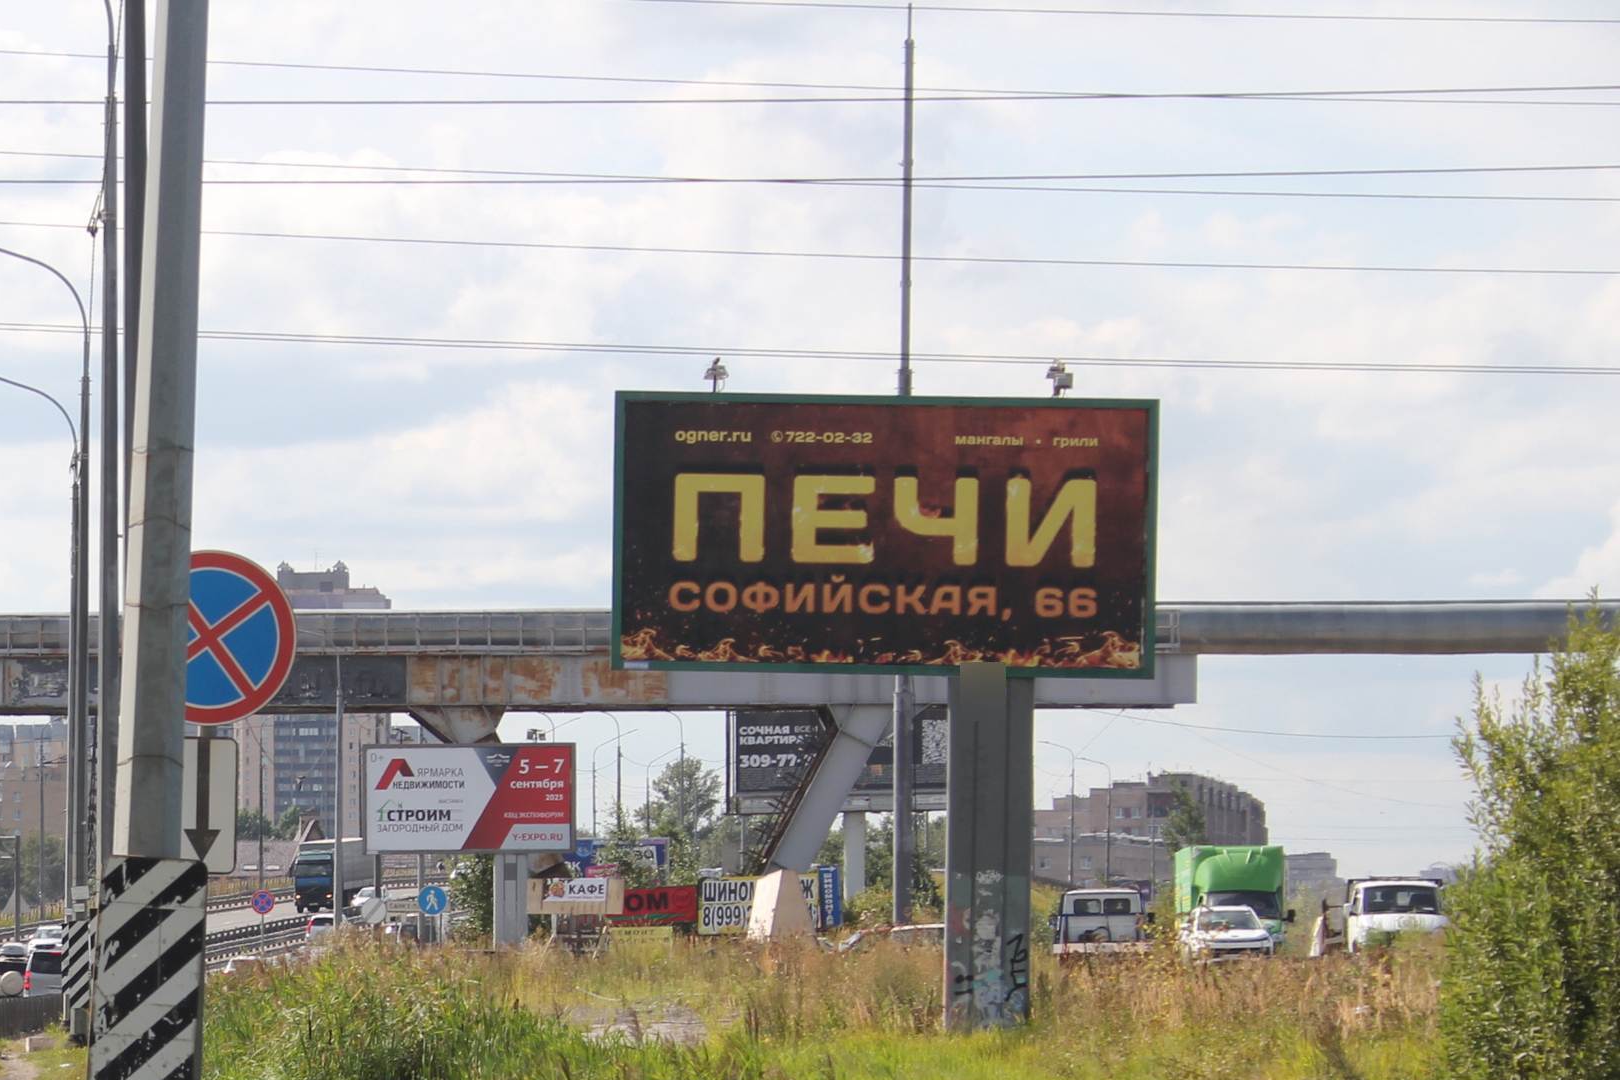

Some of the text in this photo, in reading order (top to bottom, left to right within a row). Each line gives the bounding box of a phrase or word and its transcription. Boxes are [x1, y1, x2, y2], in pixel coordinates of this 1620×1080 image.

[675, 430, 874, 444] ogner.ru 722-02-32
[955, 435, 1098, 449] мангалы грили
[671, 473, 1098, 568] ПЕЧИ
[667, 575, 1099, 622] СОФИЙСКАЯ, 66
[739, 725, 791, 736] СОЧНАЯ
[518, 759, 530, 774] 5
[553, 758, 565, 774] 7
[416, 767, 464, 777] ЯРМАРКА
[392, 780, 465, 790] НЕДВИЖИМОСТИ
[510, 779, 564, 790] сентября
[387, 809, 451, 822] СТРОИМ
[378, 822, 464, 833] ЗАГОРОДНЫЙ ДОМ
[512, 832, 564, 842] Y-EXPO.RU
[568, 884, 605, 895] КАФЕ
